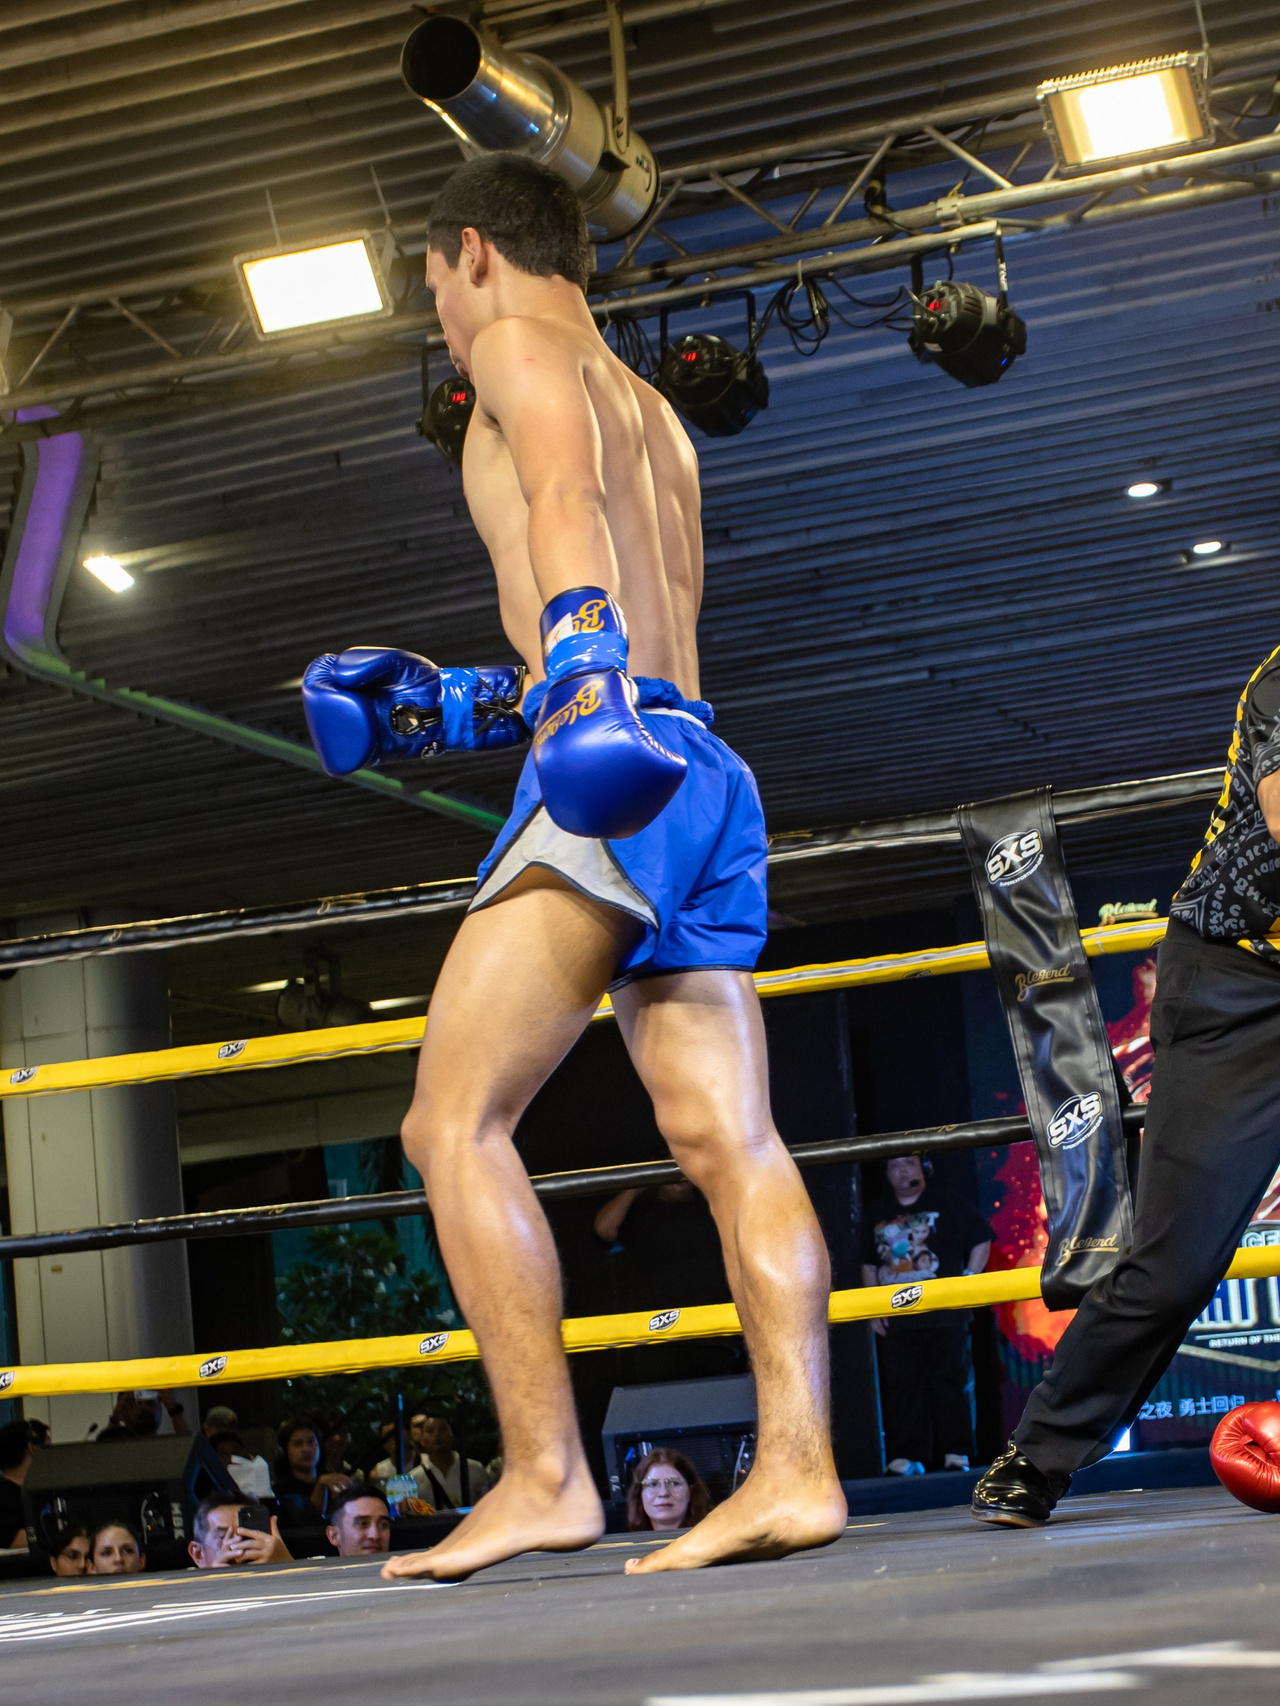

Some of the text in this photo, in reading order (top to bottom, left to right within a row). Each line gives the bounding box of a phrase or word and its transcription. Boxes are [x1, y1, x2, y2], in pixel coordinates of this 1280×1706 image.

[988, 831, 1040, 881] SXS
[1014, 962, 1075, 1002] Blegend
[218, 1039, 249, 1060] SXS
[10, 1065, 39, 1084] SXS
[1050, 1094, 1100, 1145] SXS
[891, 1285, 923, 1309] SXS
[649, 1309, 680, 1331] SXS
[419, 1333, 449, 1355] SXS
[1209, 1335, 1249, 1350] RETURN
[1248, 1334, 1263, 1346] OF
[199, 1356, 228, 1379] SXS
[0, 1371, 14, 1391] XS
[1178, 1395, 1246, 1418] 勇士回归
